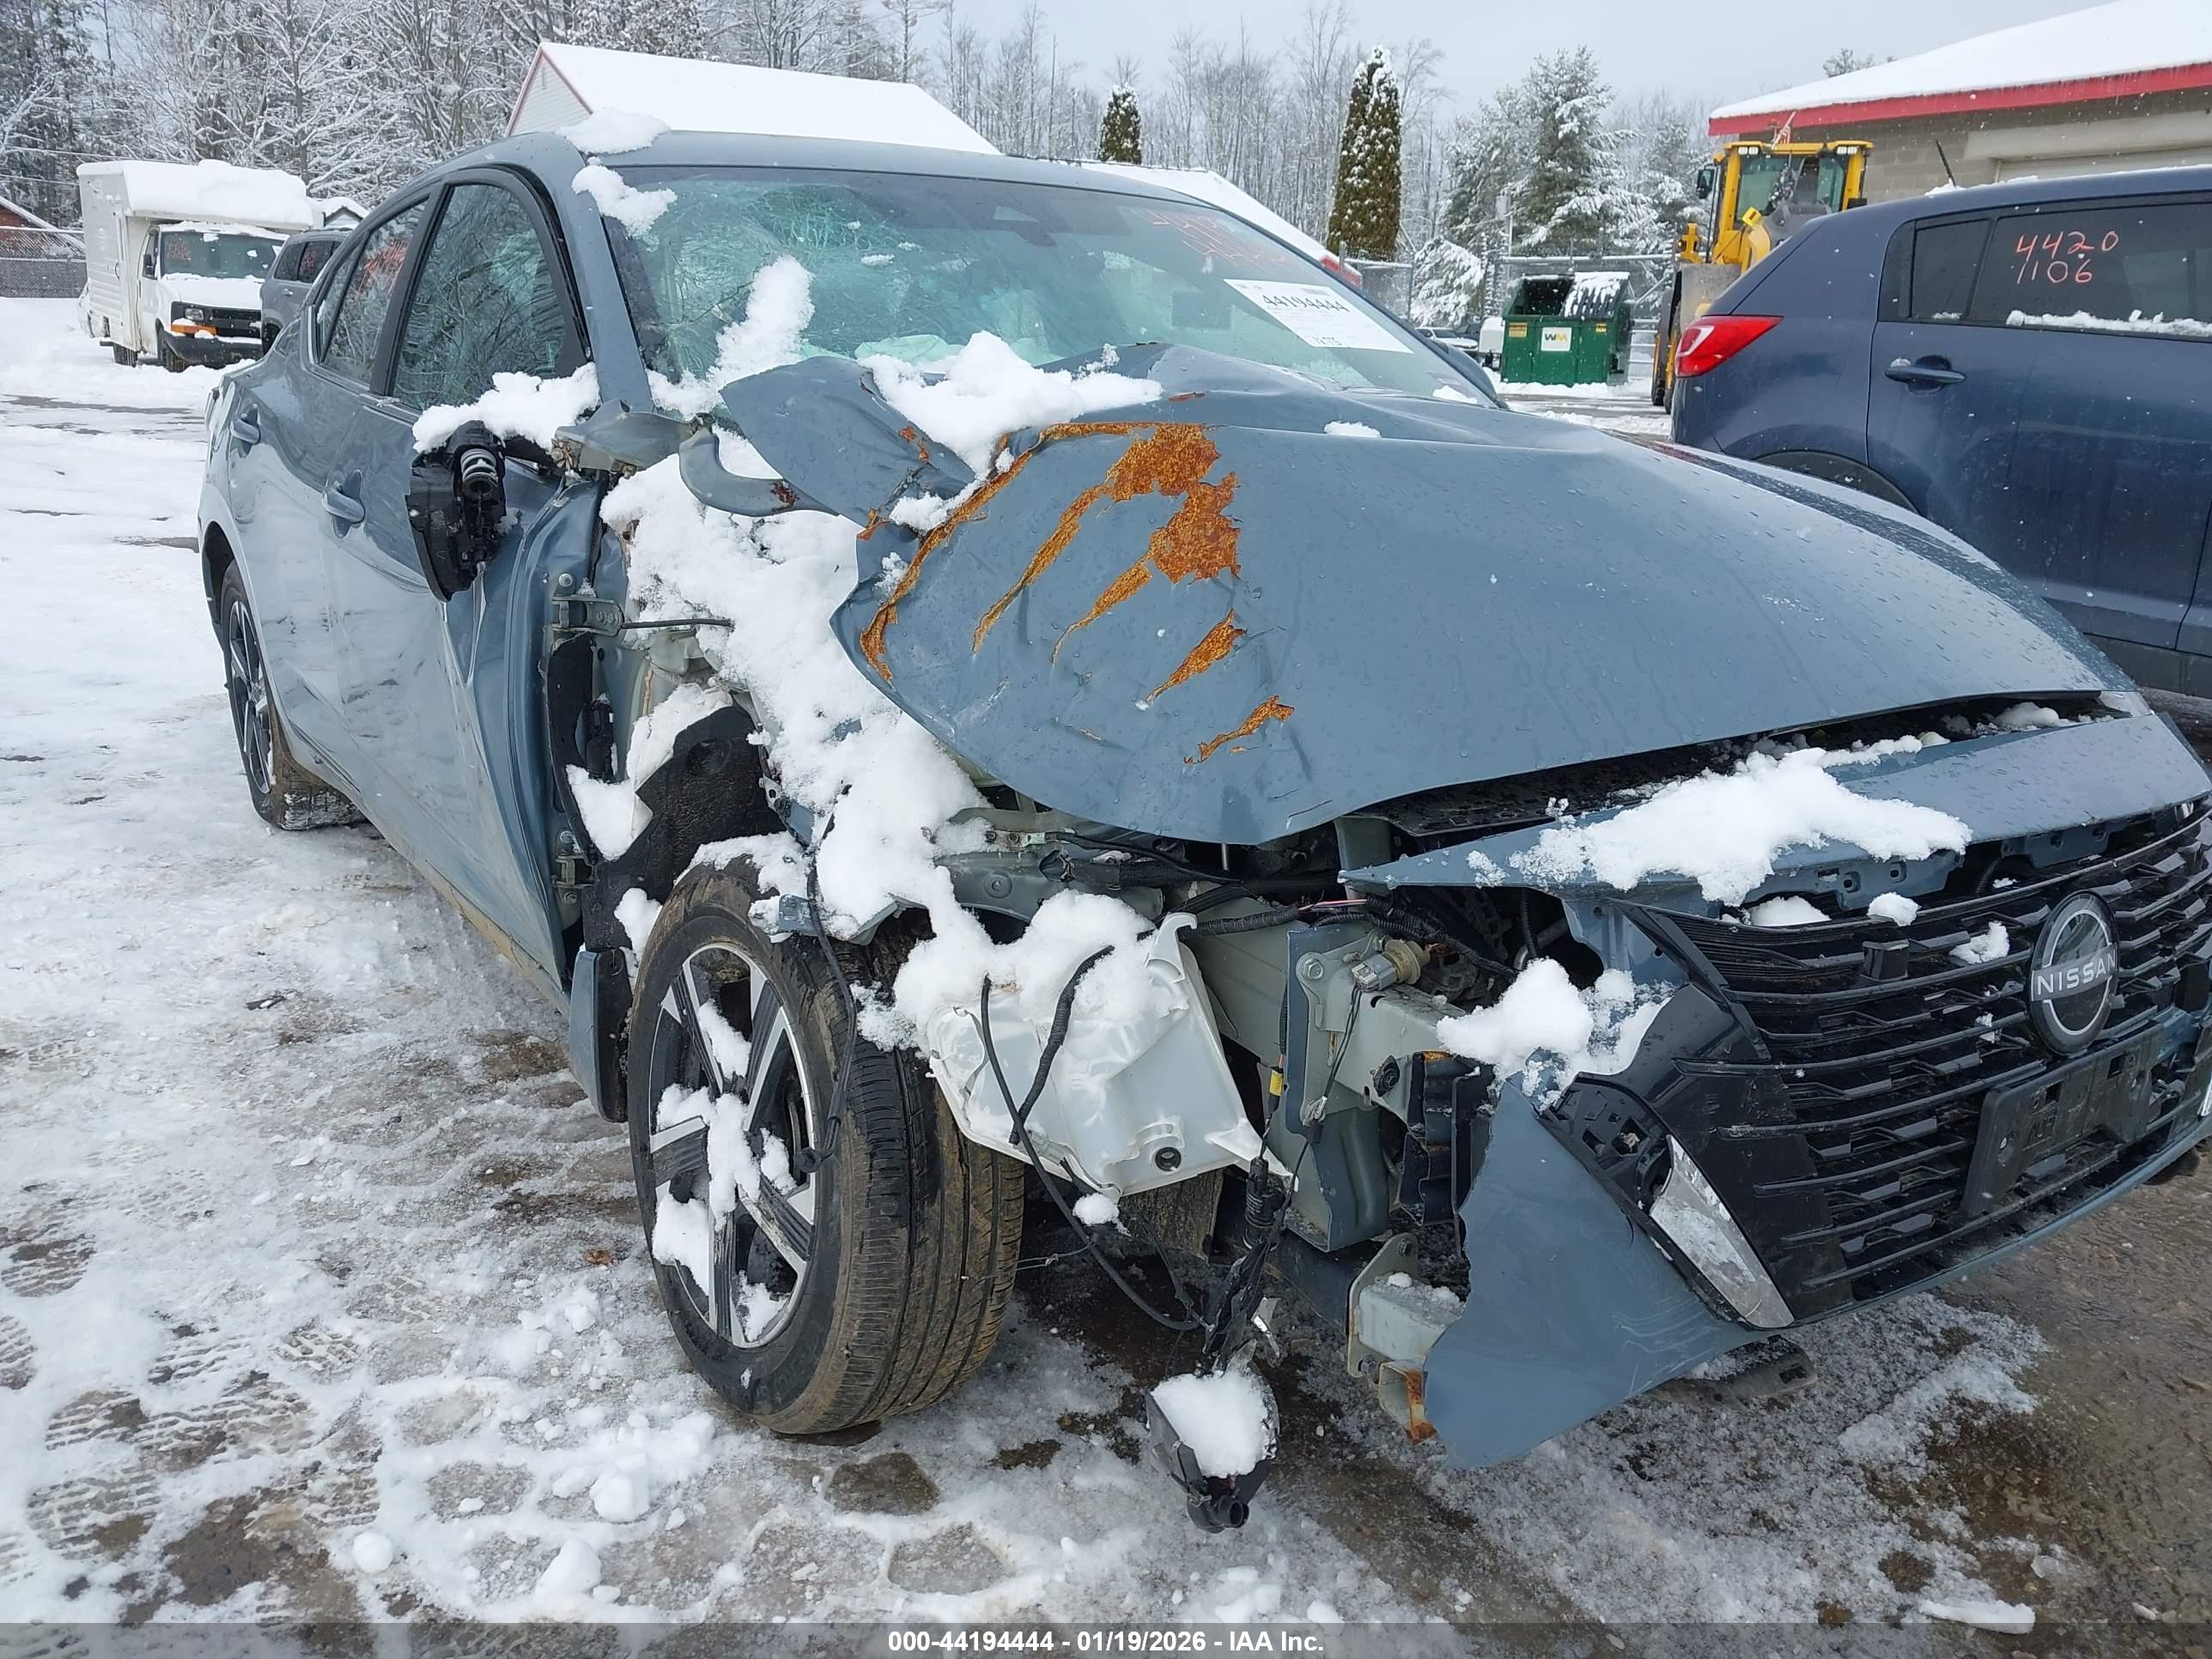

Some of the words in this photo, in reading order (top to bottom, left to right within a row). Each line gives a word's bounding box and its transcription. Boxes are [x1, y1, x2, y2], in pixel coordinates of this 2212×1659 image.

[2015, 230, 2119, 261] 4420
[2016, 258, 2093, 285] 1106
[1262, 294, 1349, 313] 44194444
[1545, 332, 1567, 342] WM
[2037, 948, 2117, 996] NISSAN
